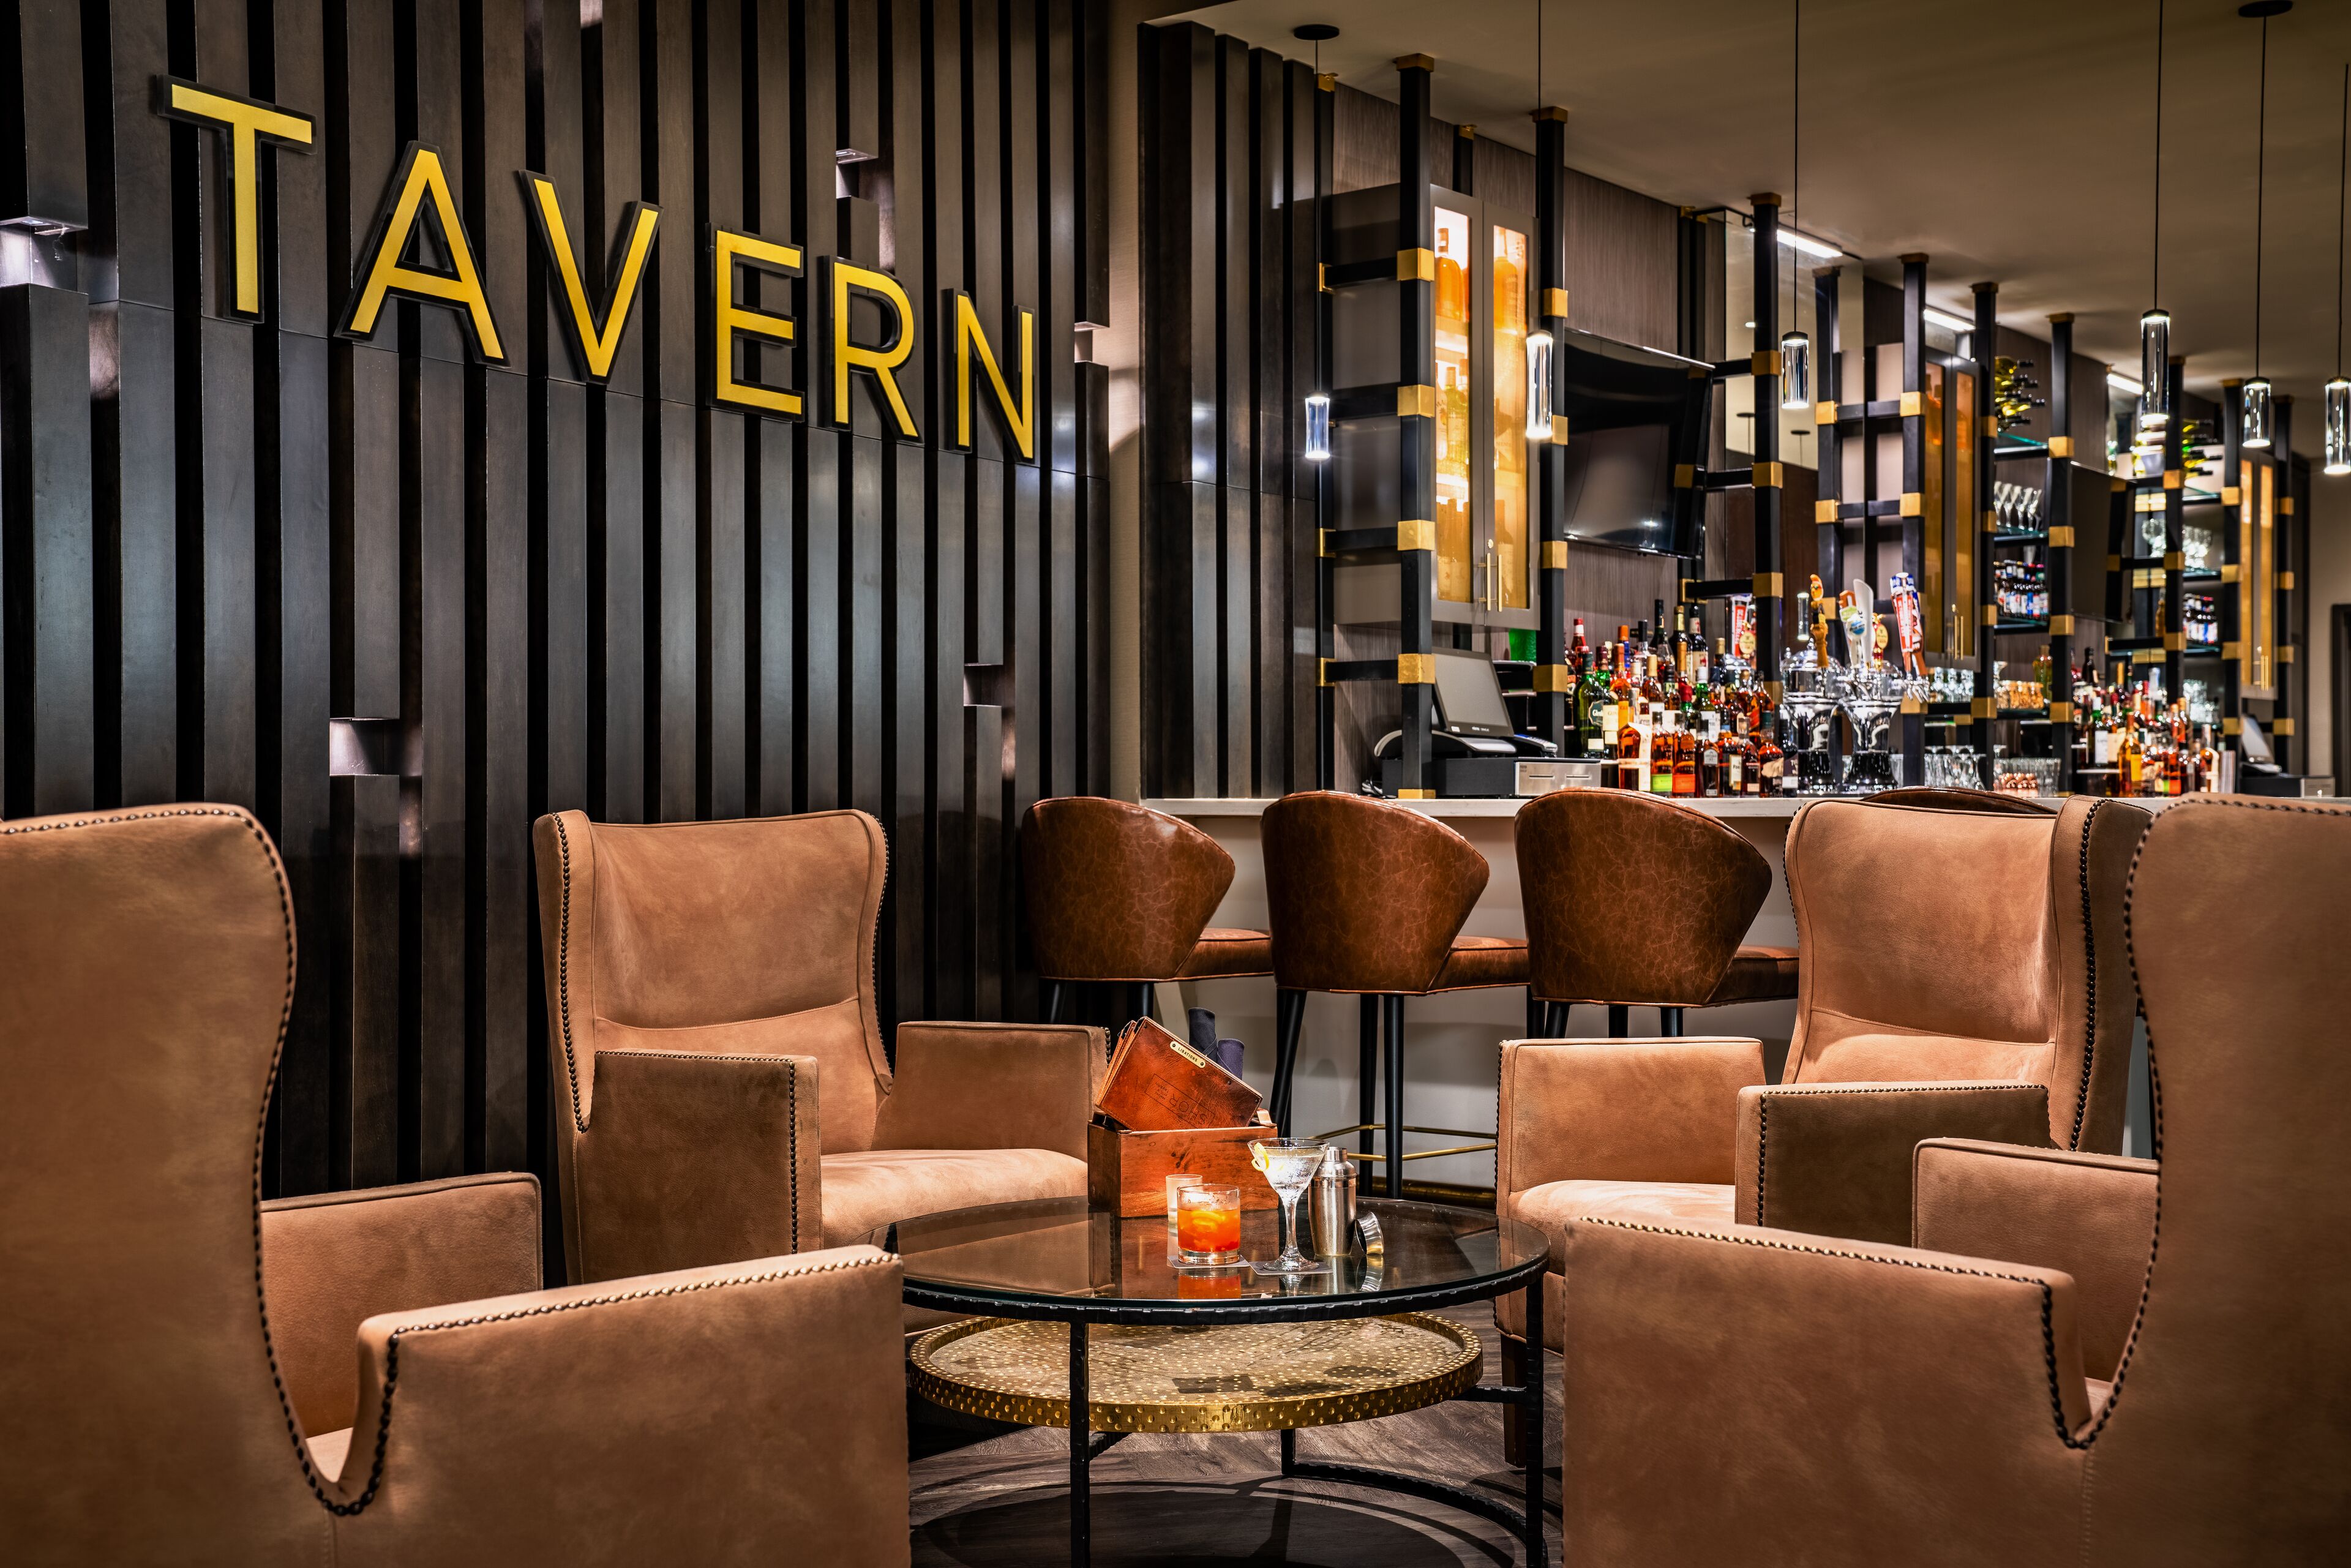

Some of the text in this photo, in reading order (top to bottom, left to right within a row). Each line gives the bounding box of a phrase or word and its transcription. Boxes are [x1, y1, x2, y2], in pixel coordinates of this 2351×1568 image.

[172, 86, 1033, 458] TAVERN
[1177, 1047, 1198, 1062] LIBATIONS
[1169, 1093, 1208, 1125] SHOR
